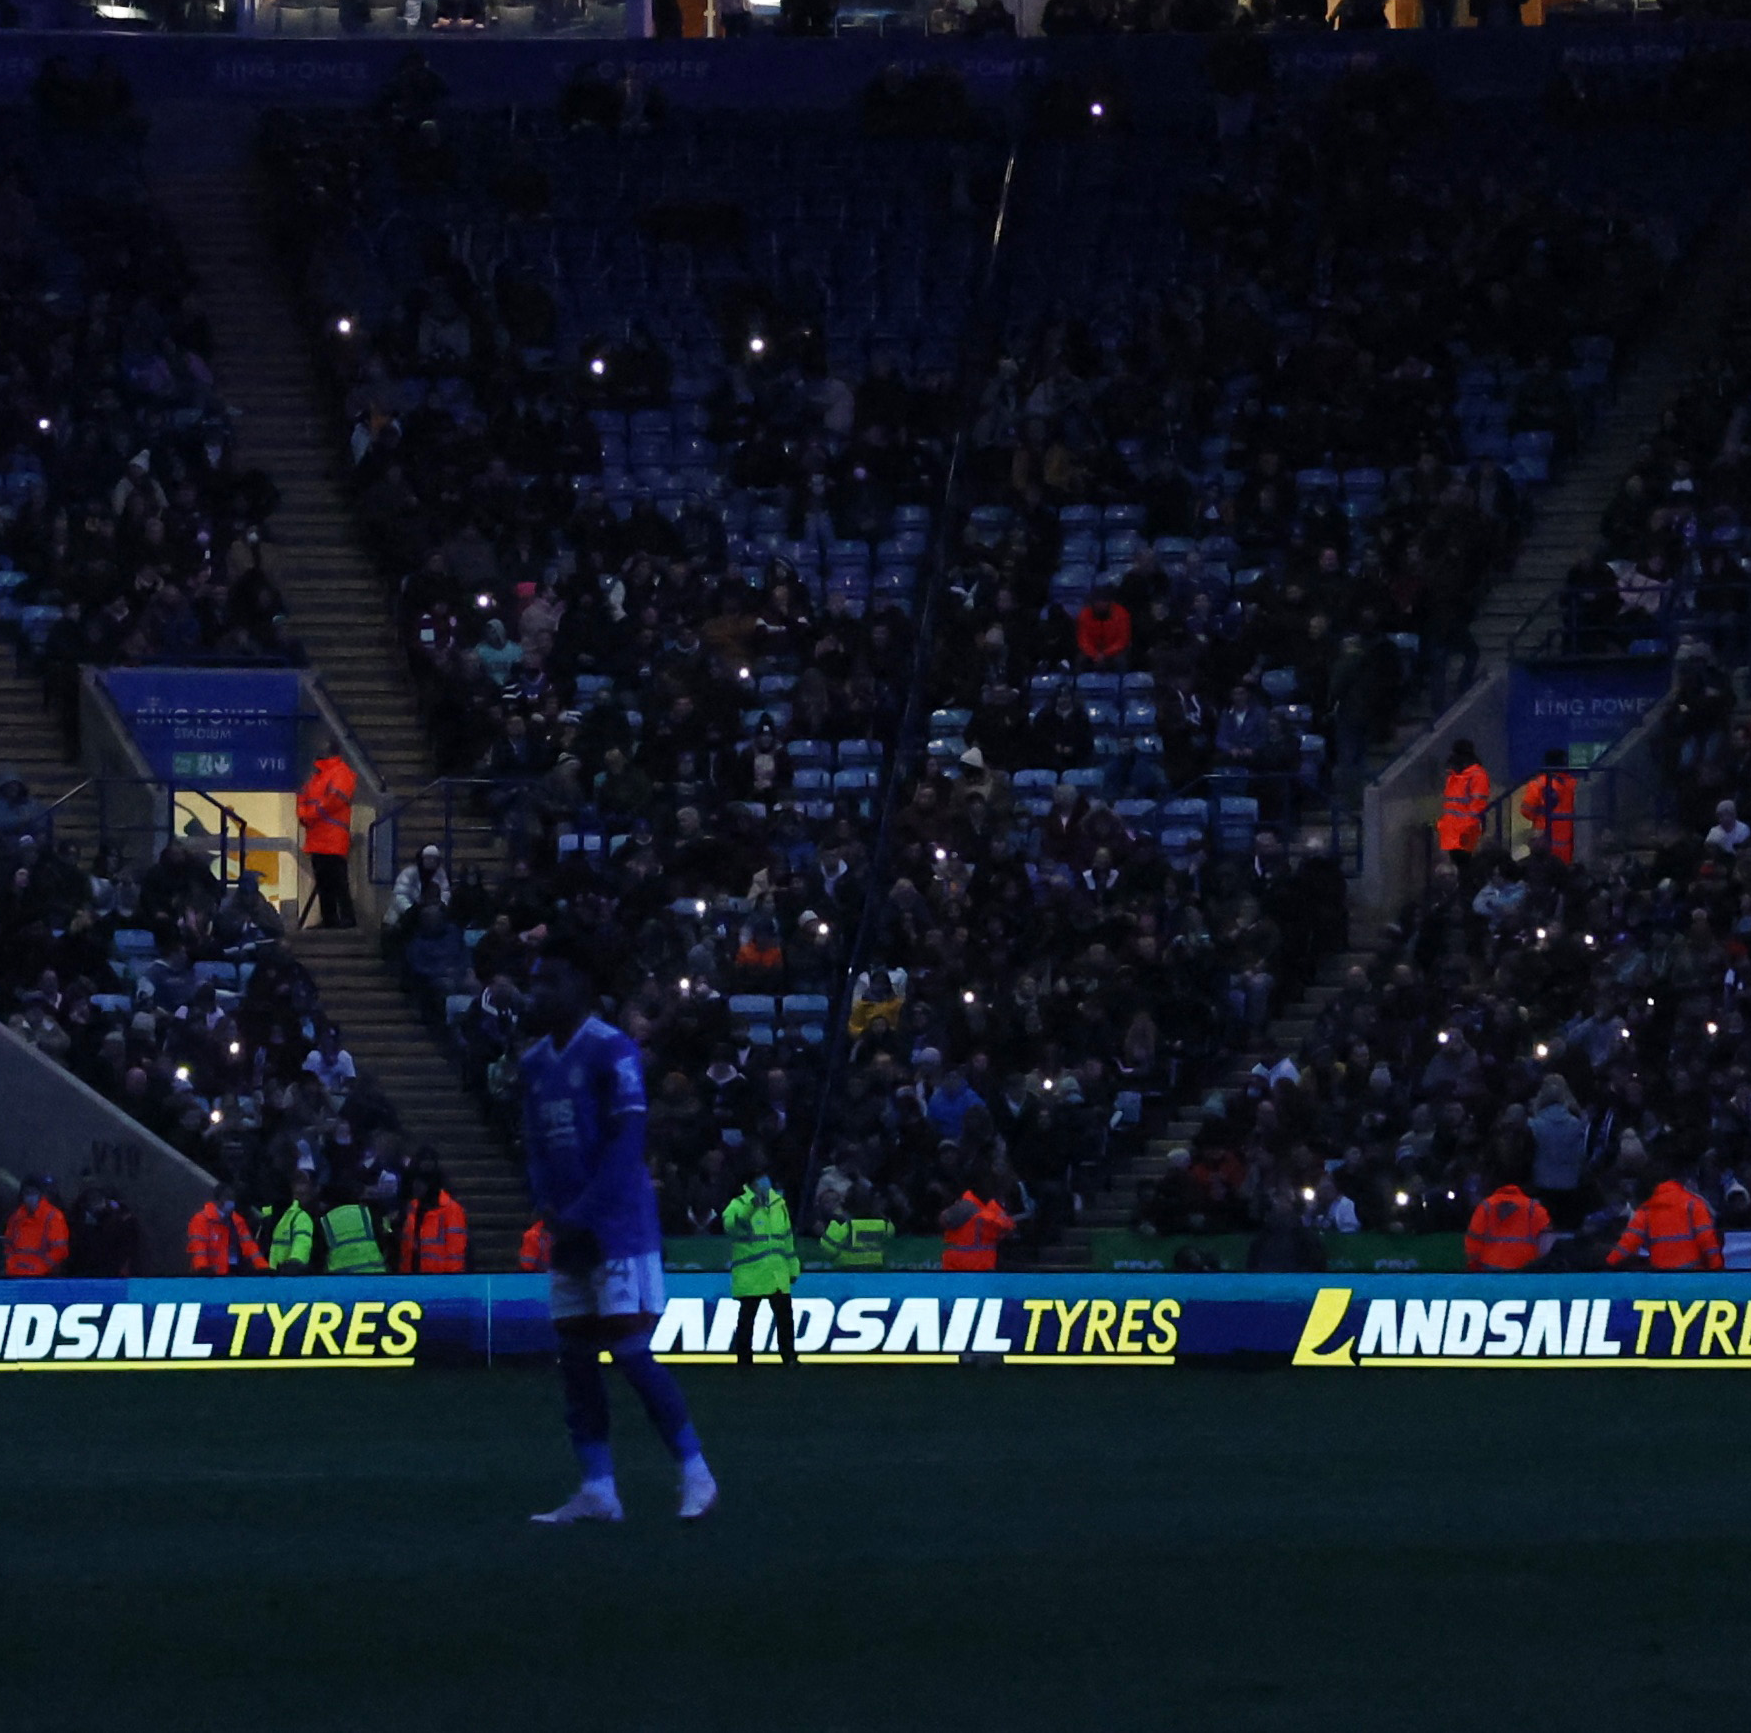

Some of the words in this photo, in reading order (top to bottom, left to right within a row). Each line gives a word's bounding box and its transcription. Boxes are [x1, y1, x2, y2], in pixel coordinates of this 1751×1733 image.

[136, 706, 190, 726] KING
[196, 706, 269, 726] POWER
[1533, 697, 1585, 716] KING
[1592, 697, 1656, 715] POWE
[173, 727, 232, 740] STADIUM
[227, 1300, 423, 1357] TYRES
[1022, 1298, 1181, 1353] TYRES
[1291, 1288, 1621, 1366] LANDSAIL
